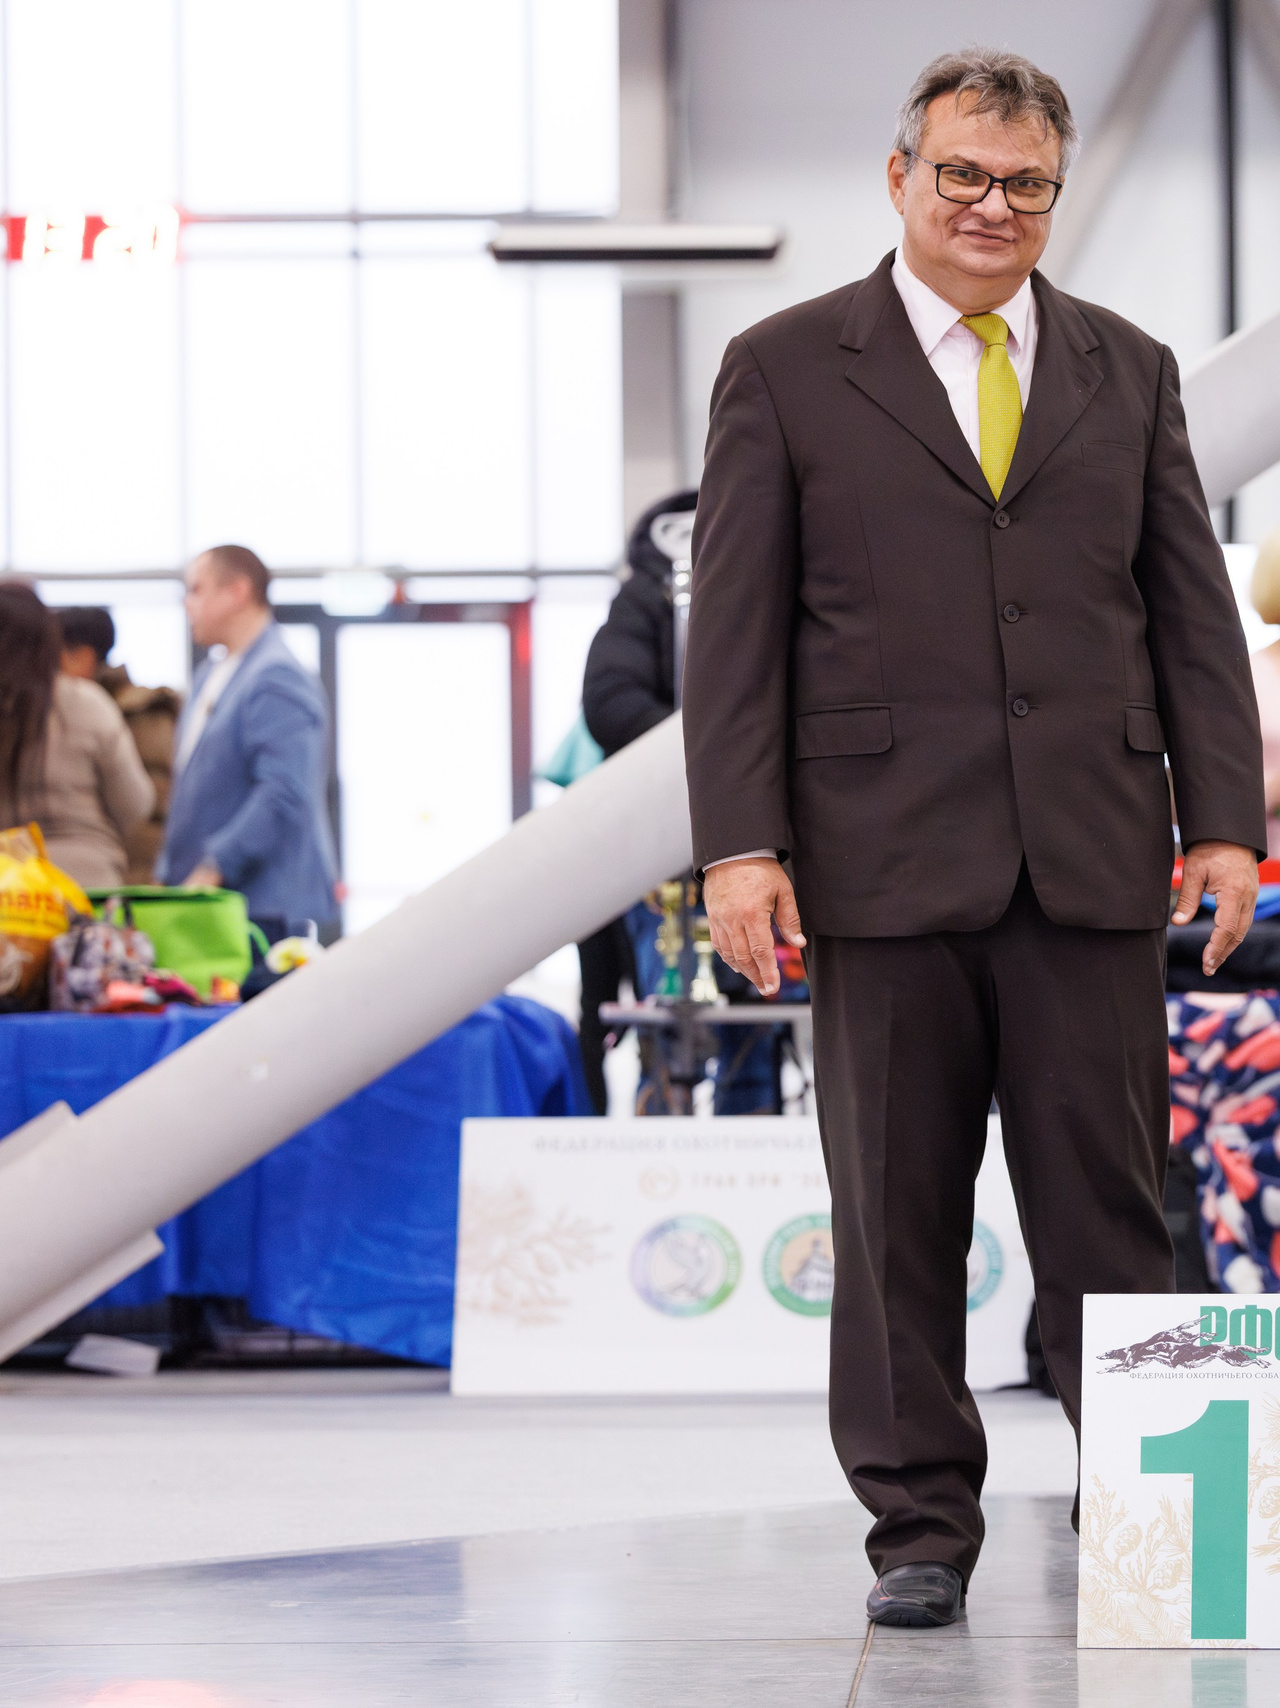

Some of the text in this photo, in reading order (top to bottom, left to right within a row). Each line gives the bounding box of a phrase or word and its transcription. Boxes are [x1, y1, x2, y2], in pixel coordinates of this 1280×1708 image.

[1129, 1372, 1184, 1380] ФЕДЕРАЦИЯ
[1186, 1372, 1253, 1380] ОХОТНИЧЬЕГО
[1140, 1400, 1249, 1640] 1
